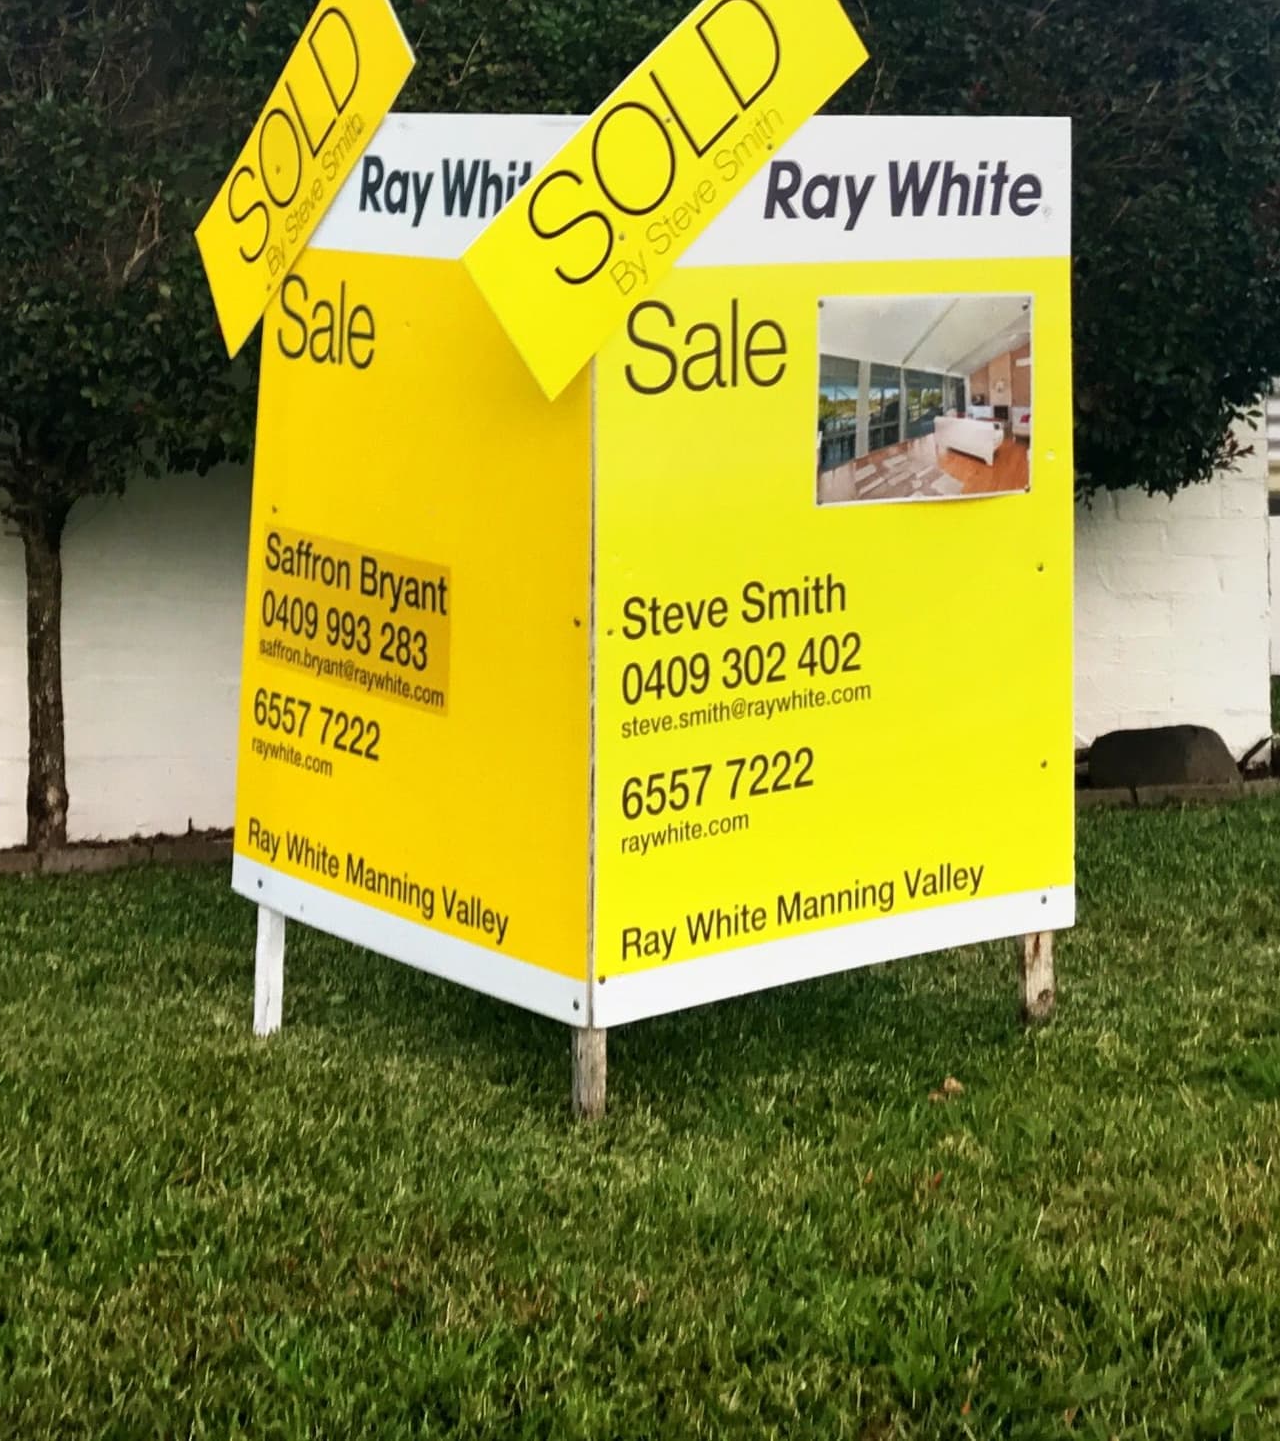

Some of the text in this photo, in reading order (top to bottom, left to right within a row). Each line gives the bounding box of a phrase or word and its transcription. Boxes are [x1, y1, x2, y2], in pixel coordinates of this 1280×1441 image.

[228, 7, 360, 263] SOLD
[265, 112, 367, 276] By Steve Smith
[359, 155, 532, 228] Ray Whi
[609, 107, 785, 296] By Steve Smith
[763, 160, 1043, 231] Ray White
[277, 274, 376, 370] Sale
[624, 297, 789, 397] Sale
[265, 532, 448, 616] Saffron Bryant
[621, 573, 847, 641] Steve Smith
[261, 589, 429, 672] 0409 993 283
[621, 630, 863, 706] 0409 302 402
[258, 637, 445, 708] saffron.bryant@raywhite.com
[621, 682, 872, 739] steve.smith@raywhite.com
[251, 735, 334, 777] raywhite.com
[254, 687, 380, 761] 6557 7222
[621, 746, 815, 821] 6557 7222
[621, 810, 750, 856] raywhite.com
[248, 817, 510, 945] Ray White Manning Valley
[621, 862, 985, 962] Ray White Manning Valley
